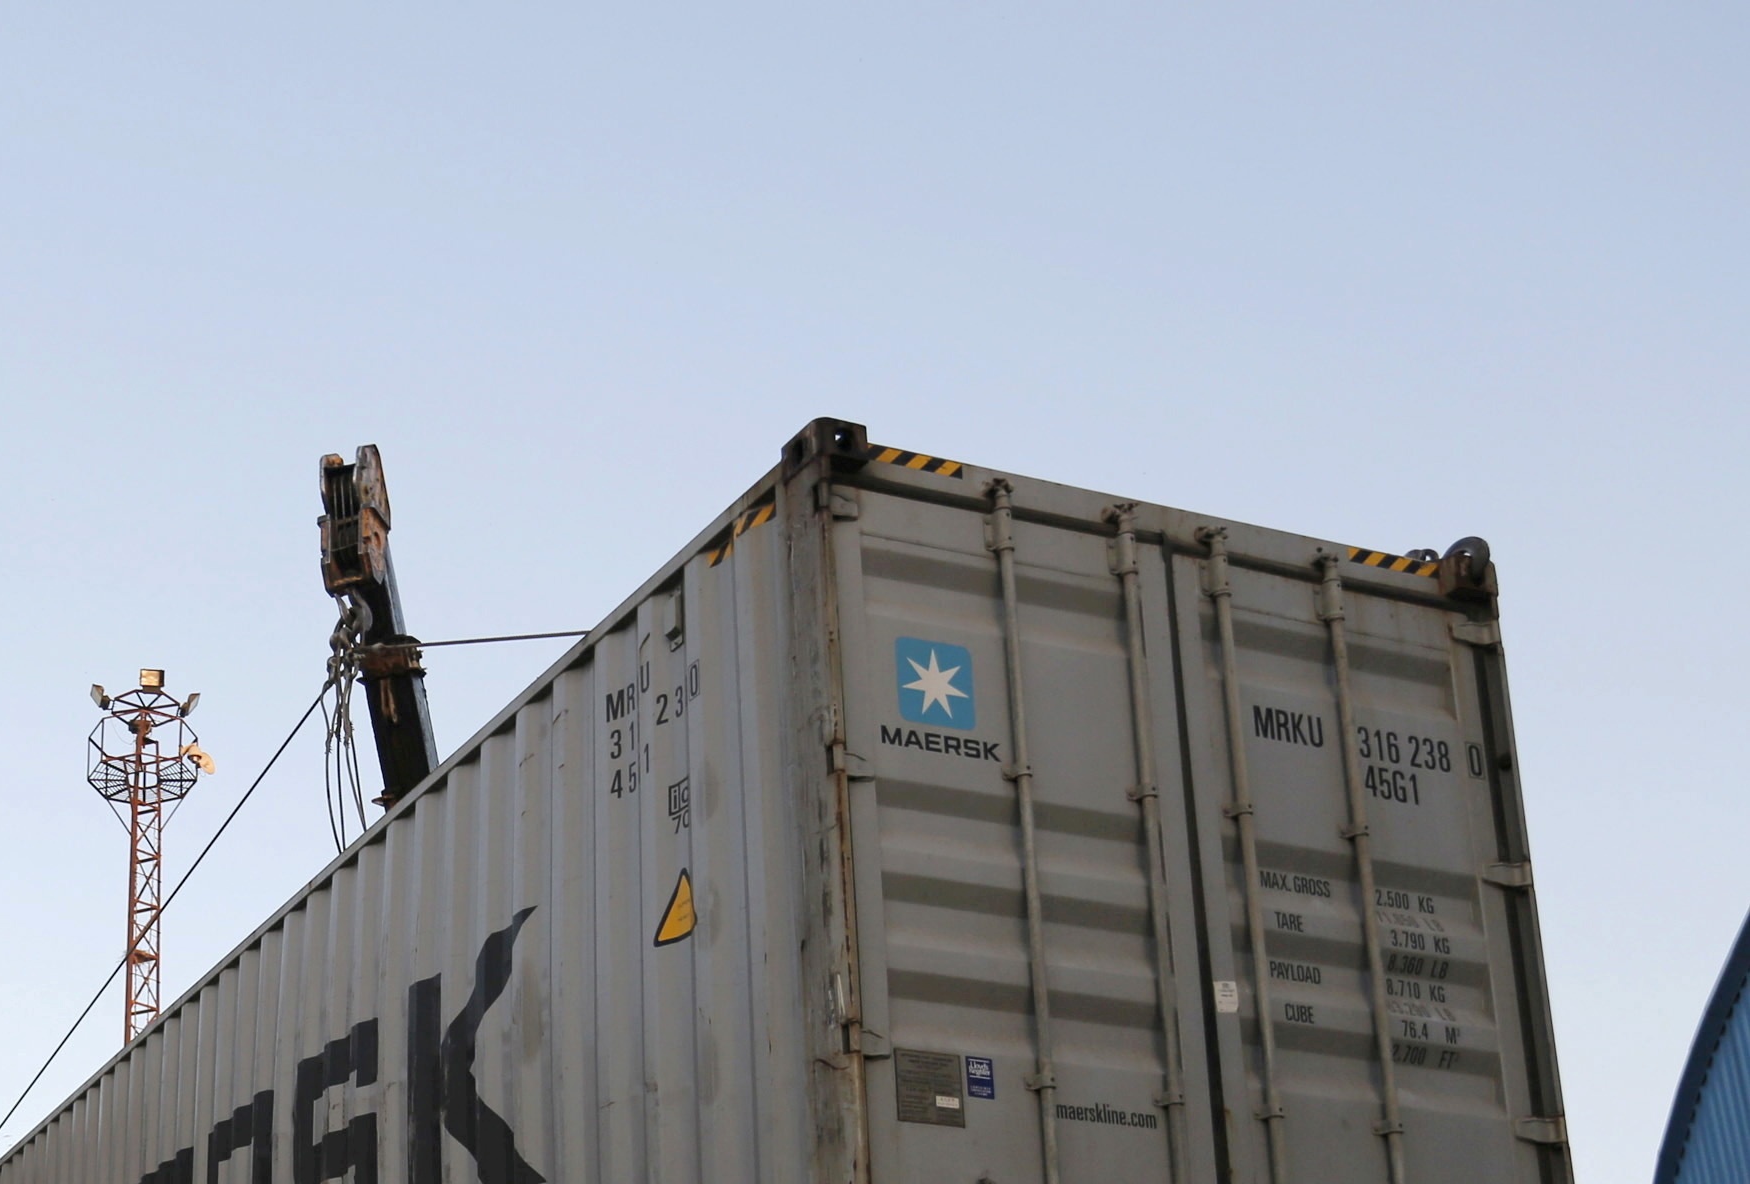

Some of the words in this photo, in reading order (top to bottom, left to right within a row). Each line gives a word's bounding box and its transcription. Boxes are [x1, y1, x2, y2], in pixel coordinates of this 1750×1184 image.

[880, 725, 1002, 762] MAERSK
[1253, 705, 1323, 748] MRKU
[1357, 726, 1400, 764] 316
[1408, 735, 1452, 773] 238
[1365, 765, 1419, 806] 45G1
[1260, 871, 1291, 892] MAX.
[1294, 876, 1331, 898] GROSS
[1418, 896, 1435, 914] KG
[1275, 912, 1304, 932] TARE
[1391, 930, 1425, 951] 3.790
[1434, 936, 1450, 955] KG
[1269, 961, 1322, 984] PAYLOAD
[1429, 984, 1446, 1003] KG
[1430, 960, 1450, 979] LB
[1285, 1003, 1314, 1024] CUBE
[1402, 1019, 1428, 1040] 76.4
[1056, 1103, 1158, 1130] maerskline.com
